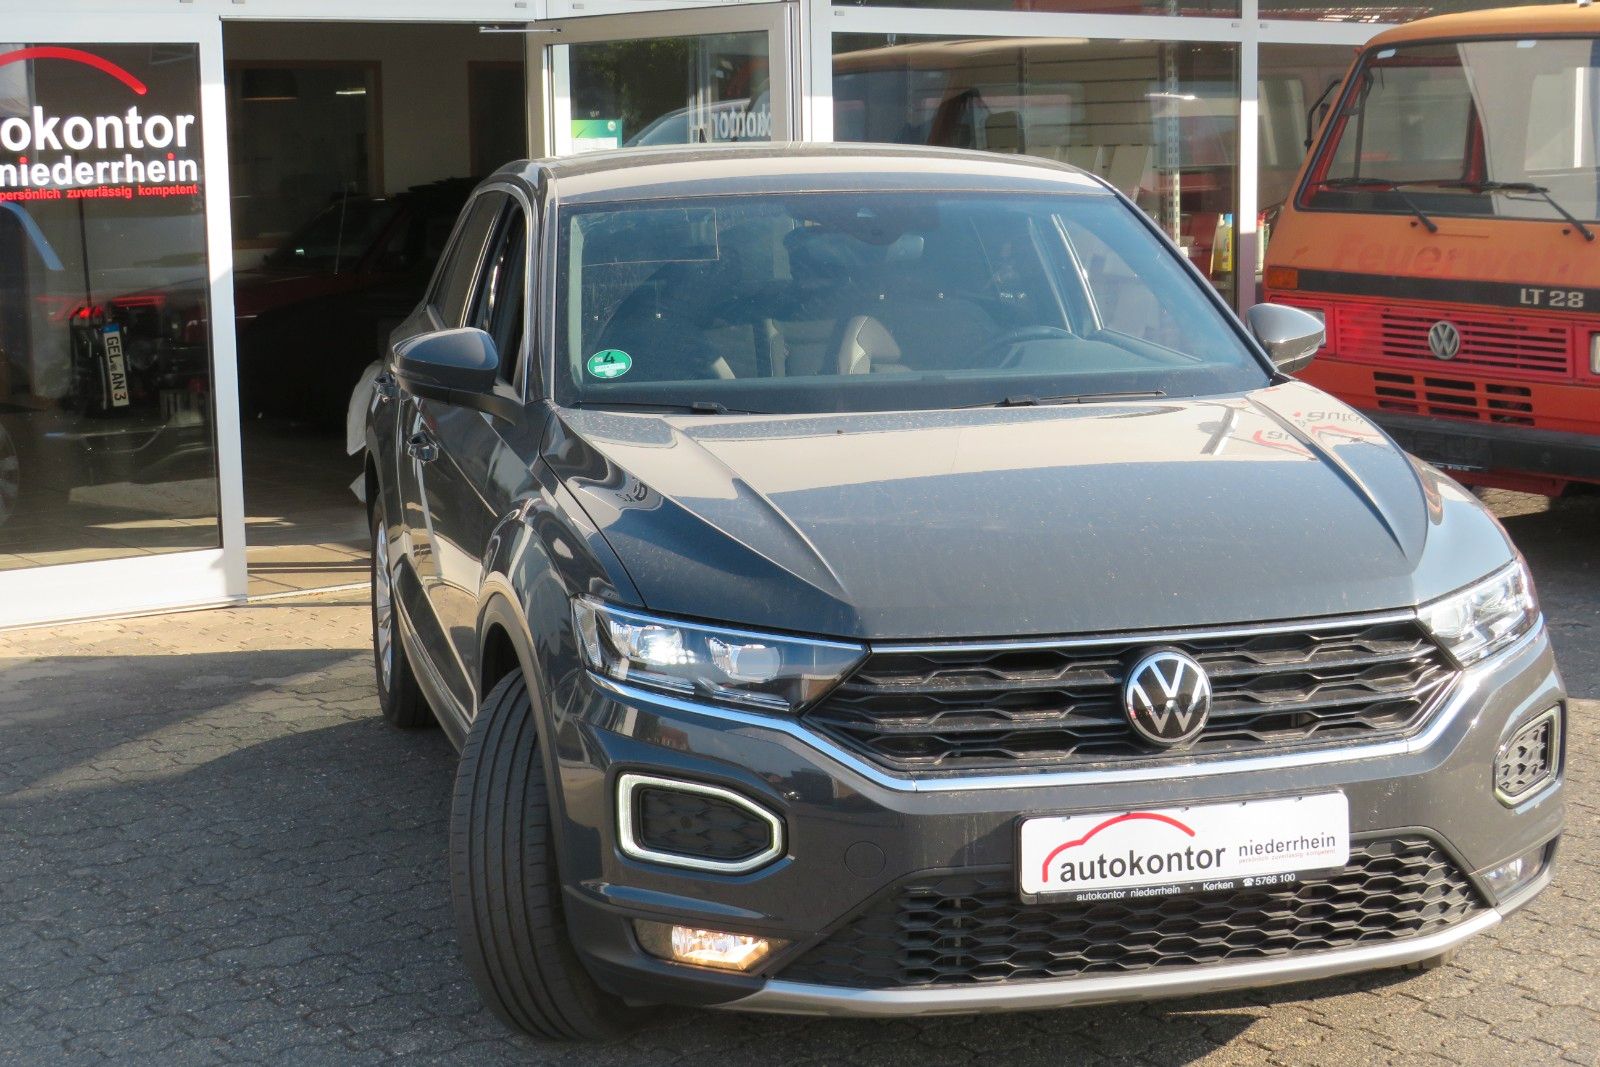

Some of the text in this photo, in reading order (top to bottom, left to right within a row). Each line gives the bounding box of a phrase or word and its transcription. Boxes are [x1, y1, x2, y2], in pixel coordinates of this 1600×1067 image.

[0, 152, 198, 187] niederrhein
[66, 185, 133, 199] zuverlässig
[138, 184, 198, 197] kompetent
[1520, 288, 1584, 308] LT 28
[106, 336, 127, 401] GEL AN 3
[603, 351, 615, 364] 4
[1125, 650, 1211, 743] VW
[1059, 831, 1336, 883] autokontor niederrhein
[1076, 872, 1296, 902] autokontor niederrhein Kerken 5766 100
